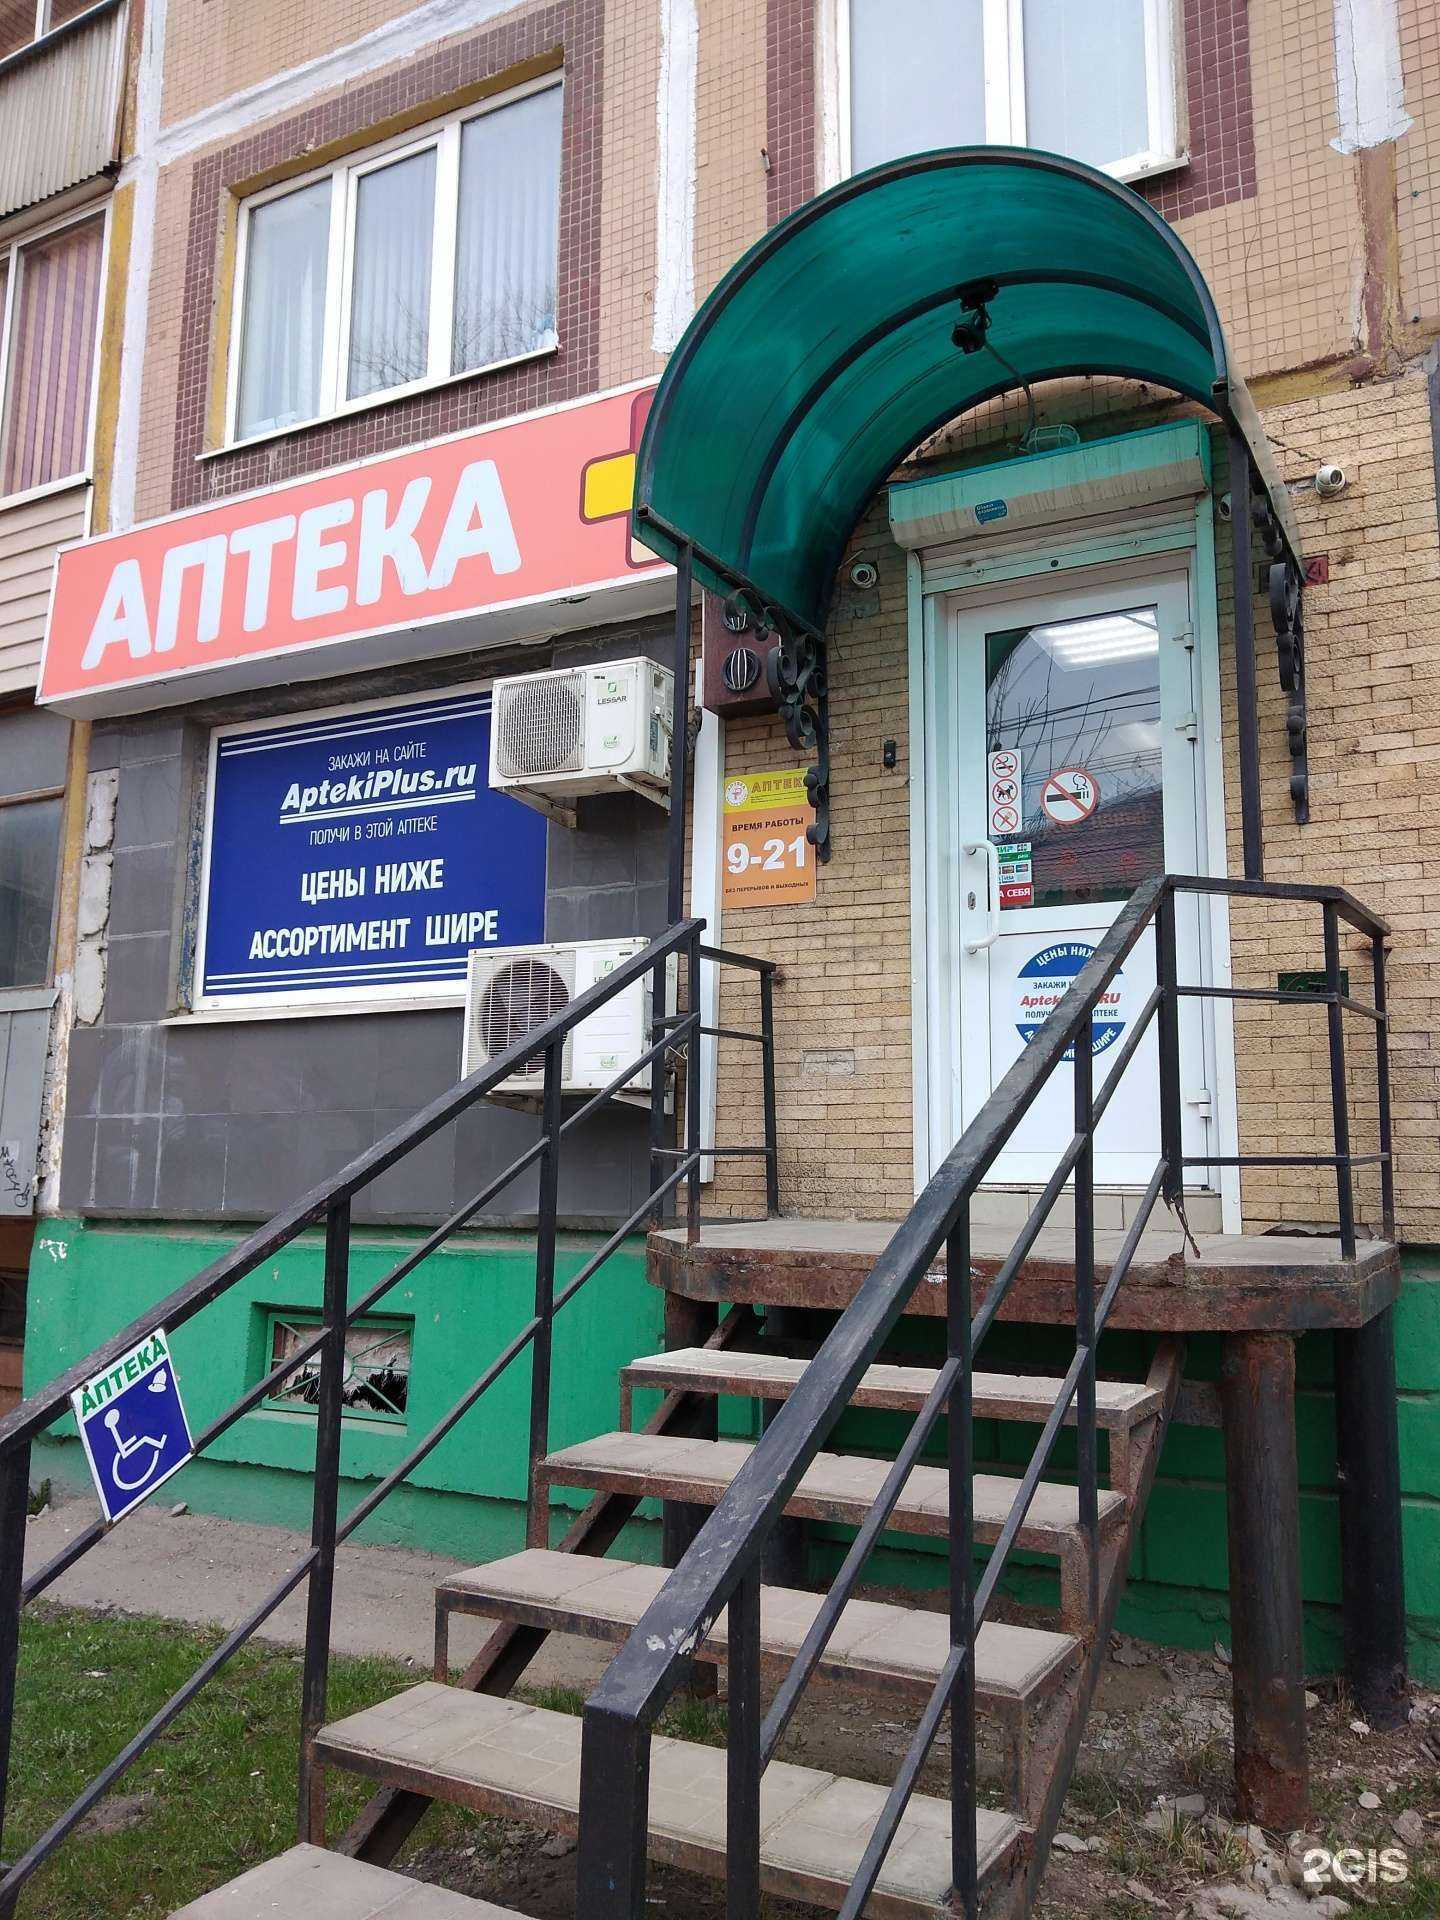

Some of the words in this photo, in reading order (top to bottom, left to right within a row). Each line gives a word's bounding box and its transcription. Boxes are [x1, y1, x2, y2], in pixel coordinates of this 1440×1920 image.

[81, 459, 522, 670] АПТЕКА
[597, 695, 627, 705] LESSAR
[328, 750, 371, 771] ЗАКАЖИ
[375, 748, 389, 763] НА
[393, 740, 426, 761] САЙТЕ
[280, 763, 477, 814] AptekiPlus.ru
[751, 776, 805, 793] АПТЕК
[309, 826, 350, 846] ПОЛУЧИ
[354, 825, 362, 840] В
[365, 817, 393, 839] ЭТОЙ
[397, 815, 438, 836] АПТЕКЕ
[732, 822, 763, 832] ВРЕМЯ
[765, 817, 804, 829] РАБОТЫ
[727, 835, 806, 874] 9-21
[301, 866, 366, 905] ЦЕНЫ
[374, 858, 444, 894] НИЖЕ
[1007, 887, 1031, 898] СЕБЯ
[248, 917, 411, 960] АССОРТИМЕНТ
[424, 909, 499, 946] ШИРЕ
[1035, 946, 1067, 967] ЦЕНЫ
[1070, 946, 1095, 959] НИЖ
[1033, 980, 1067, 990] ЗАКАЖИ
[1025, 1010, 1051, 1018] ПОЛУЧ
[1092, 1009, 1119, 1017] ПТЕКЕ
[82, 1338, 167, 1417] АПТЕКА
